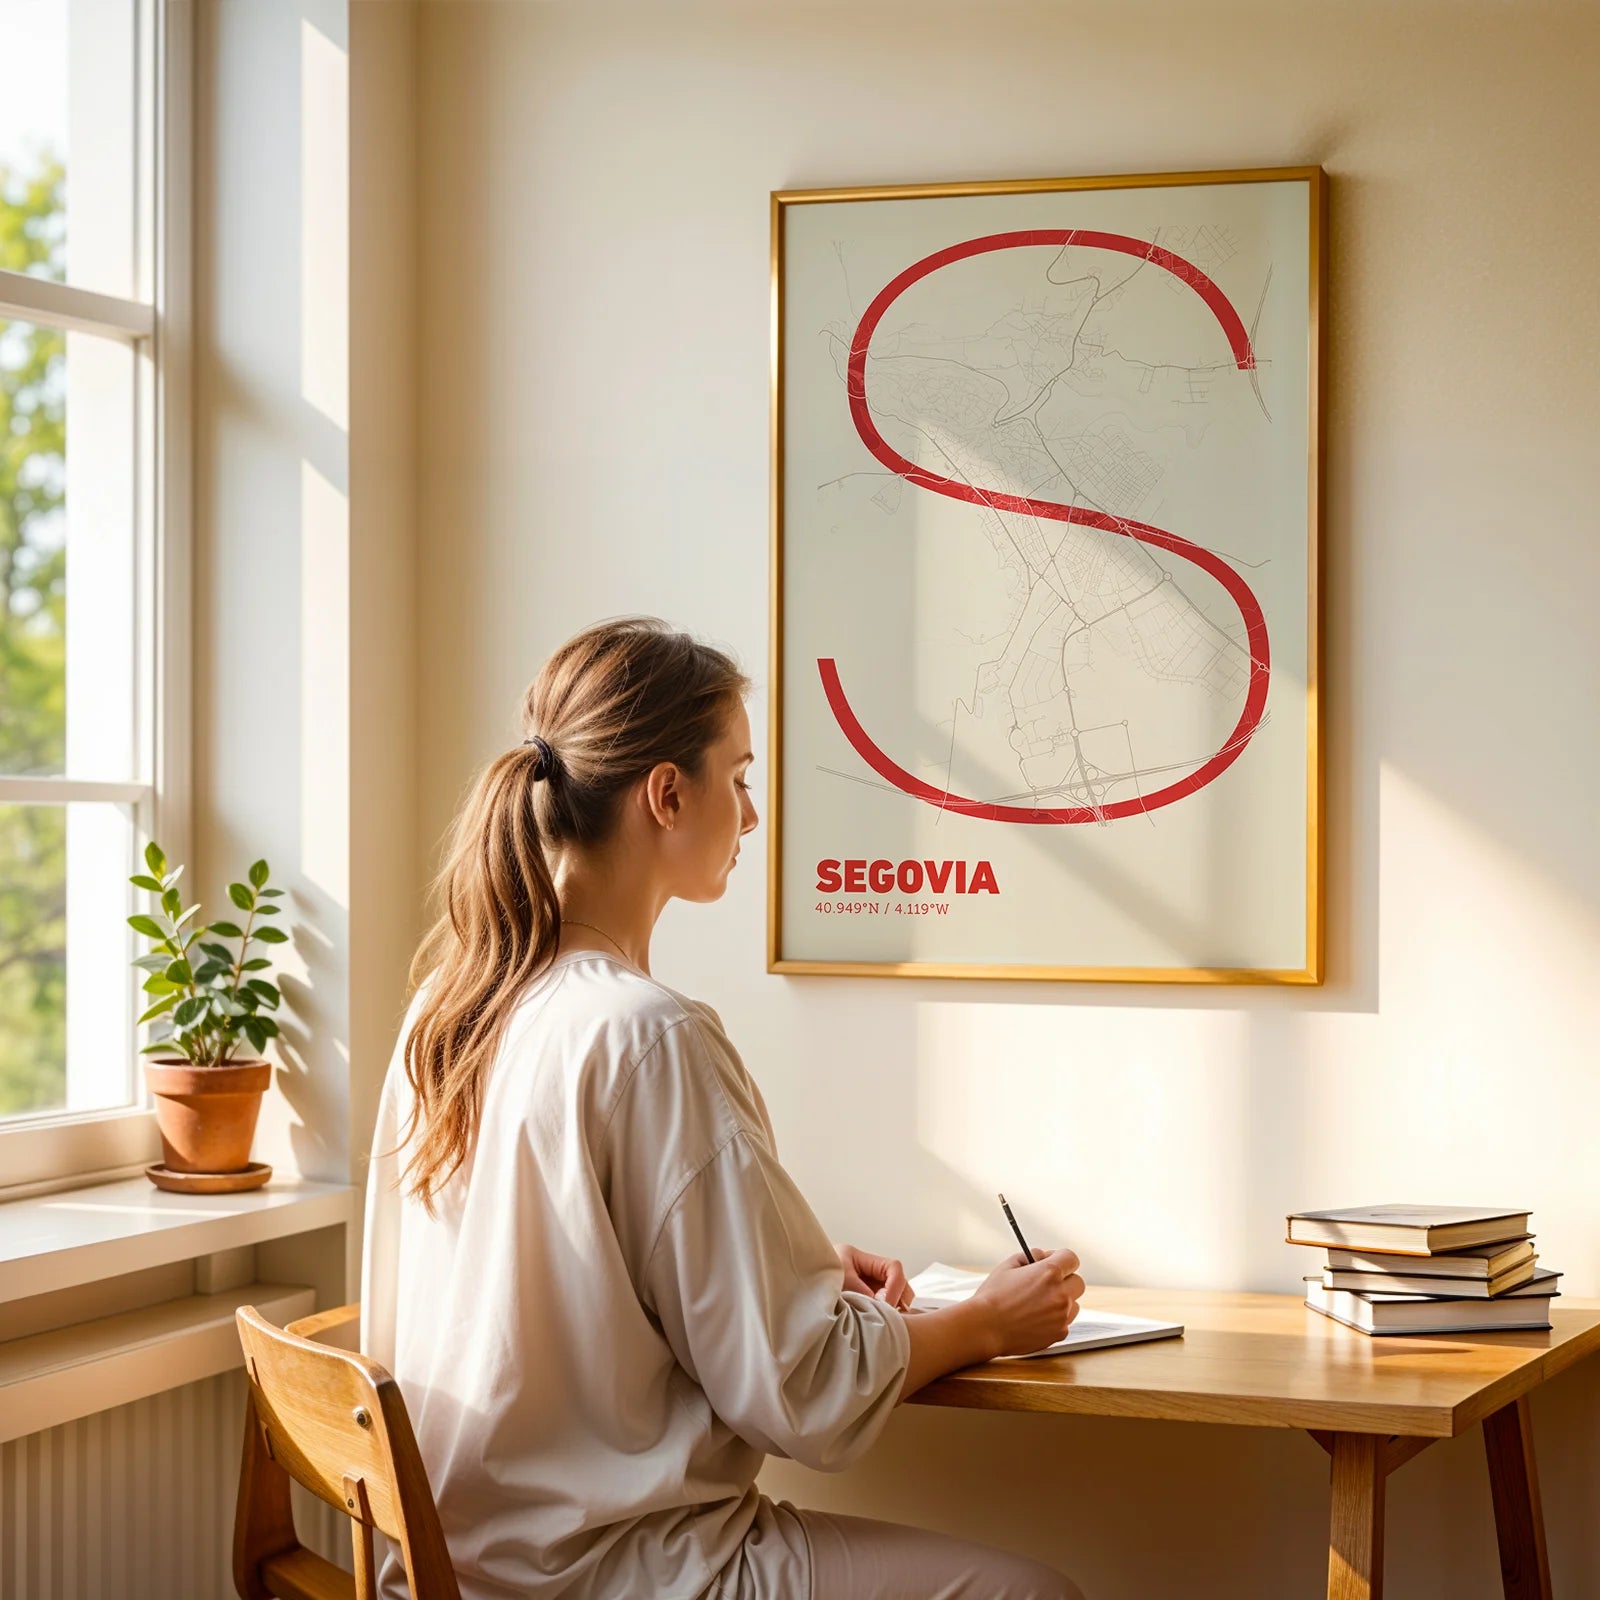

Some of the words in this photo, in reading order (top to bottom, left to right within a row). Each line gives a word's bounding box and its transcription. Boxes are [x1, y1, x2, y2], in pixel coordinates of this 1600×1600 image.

[815, 858, 1000, 895] SEGOVIA
[814, 902, 880, 915] 40.949°N
[894, 902, 949, 916] 4.119°W
